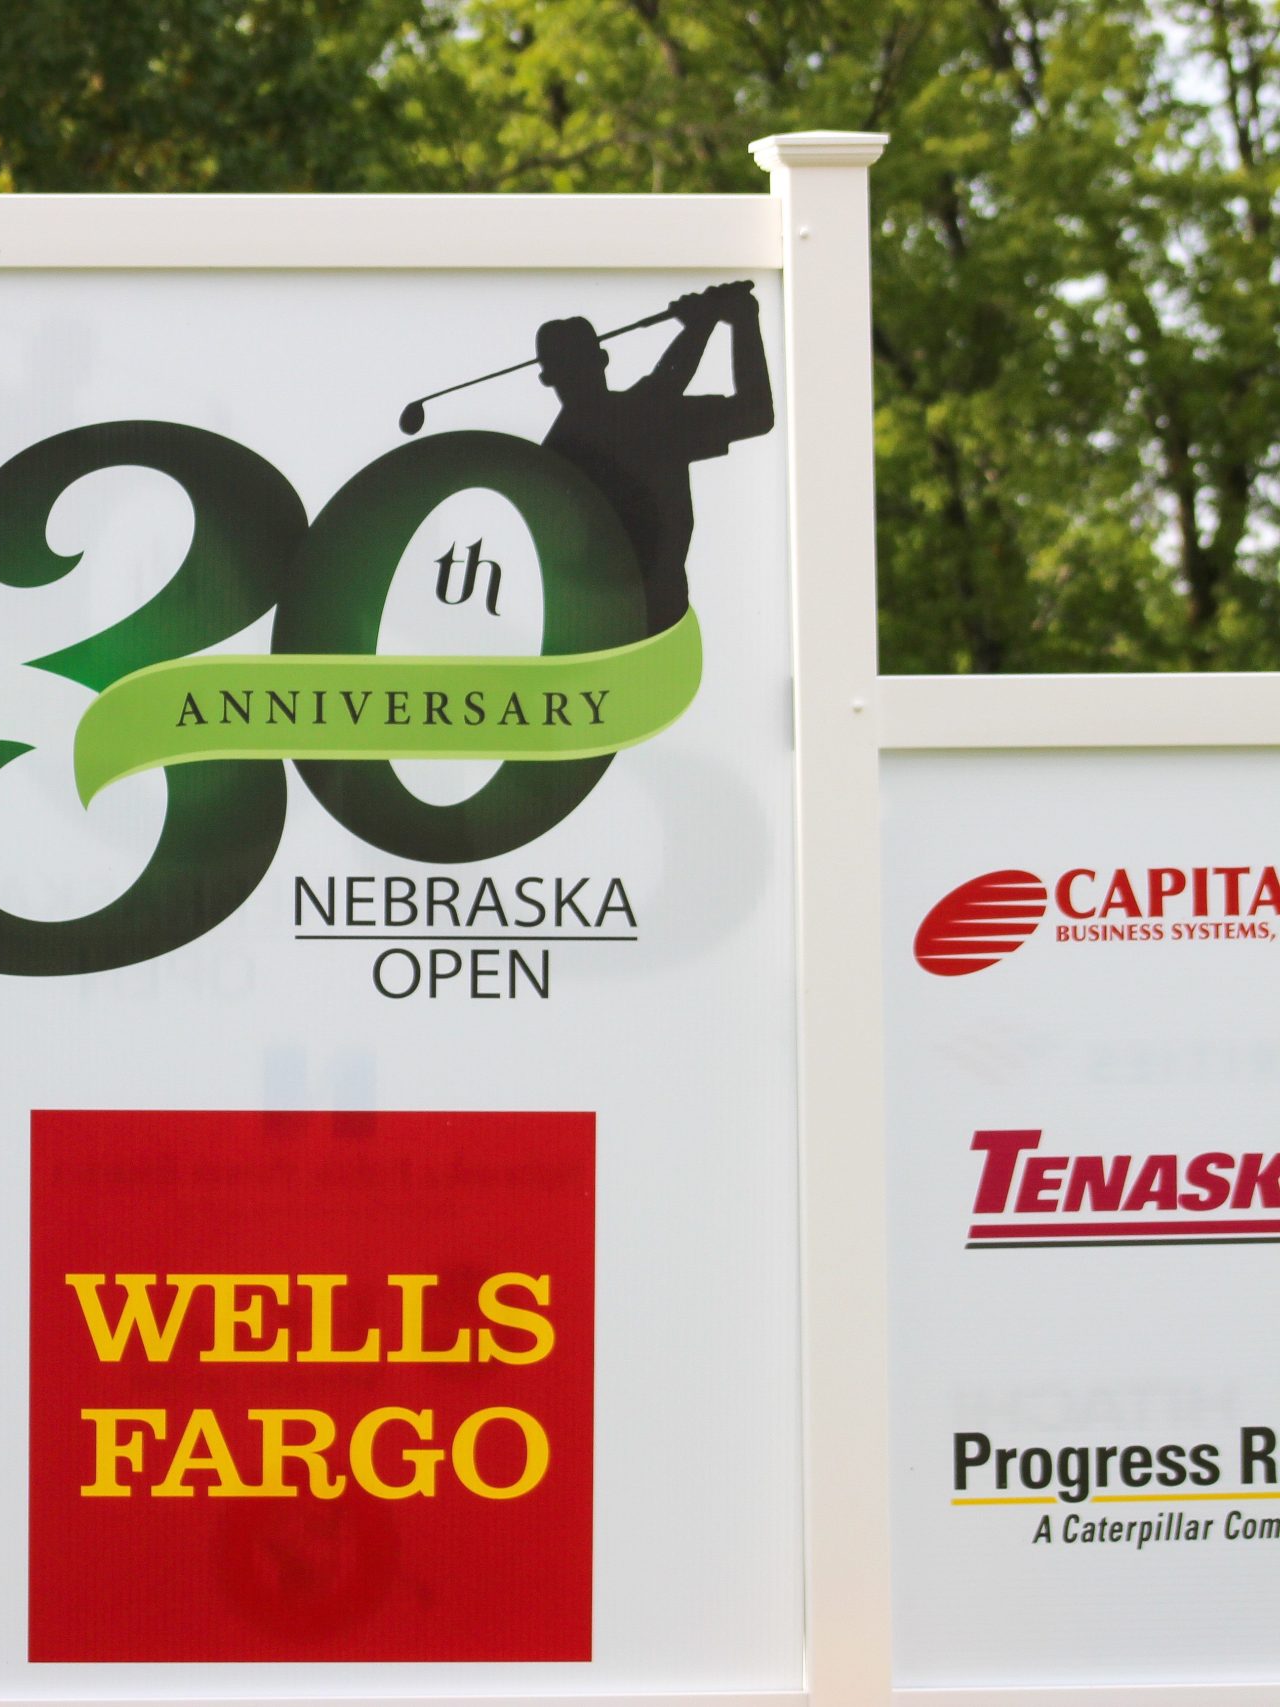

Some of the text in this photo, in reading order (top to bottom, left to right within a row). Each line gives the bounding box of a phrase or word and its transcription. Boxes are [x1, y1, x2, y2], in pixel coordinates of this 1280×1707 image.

[433, 537, 502, 616] th
[175, 690, 612, 727] ANNIVERSARY
[293, 875, 638, 928] NEBRASKA
[1054, 866, 1280, 920] CAPITA
[1055, 920, 1276, 943] BUSINESS SYSTEMS,
[372, 947, 551, 1002] OPEN
[970, 1129, 1280, 1214] TENASK
[66, 1271, 555, 1365] WELLS
[79, 1404, 551, 1500] FARGO
[953, 1426, 1277, 1503] Progress R
[1032, 1510, 1280, 1551] A Caterpillar Com
